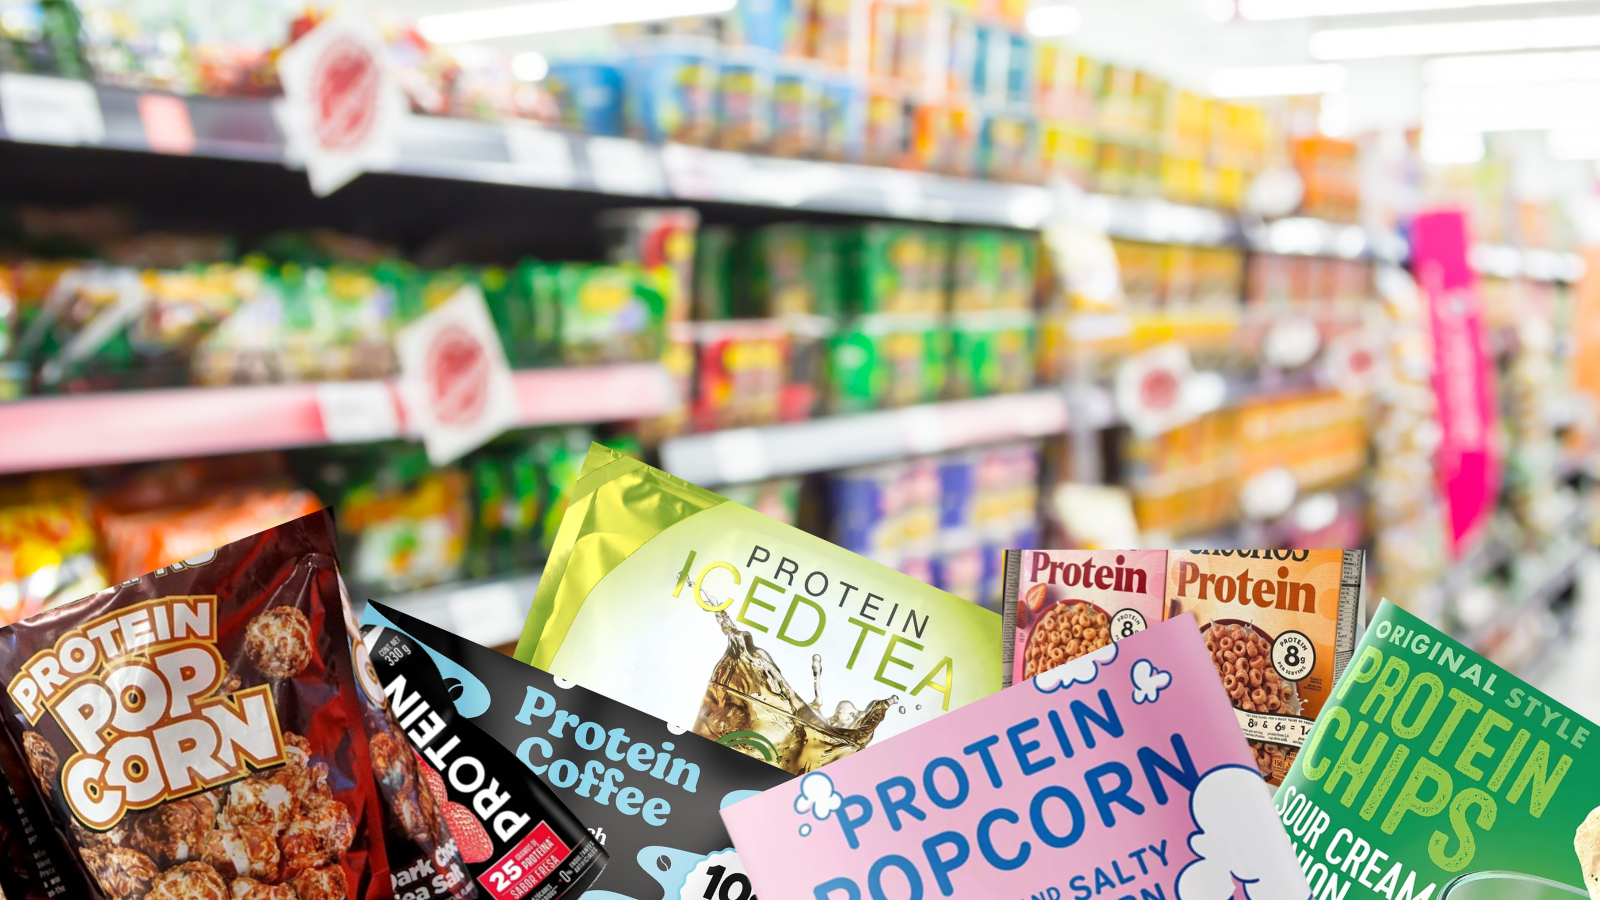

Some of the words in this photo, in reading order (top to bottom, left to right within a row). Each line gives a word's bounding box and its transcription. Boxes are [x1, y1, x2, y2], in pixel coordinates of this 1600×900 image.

[746, 545, 929, 639] PROTEIN
[1030, 552, 1147, 594] Protein
[1117, 614, 1140, 625] PROTEIN
[1177, 561, 1316, 614] Protein
[9, 597, 217, 724] PROTEIN
[384, 647, 404, 667] 330
[401, 644, 412, 656] g
[672, 549, 827, 648] ICED
[845, 616, 953, 712] TEA
[1280, 636, 1308, 652] PROTEIN
[1284, 645, 1306, 667] 8g
[51, 643, 225, 757] POP
[1336, 645, 1574, 819] PROTEIN
[1376, 620, 1498, 696] ORIGINAL
[1504, 687, 1591, 750] STYLE
[63, 687, 284, 828] CORN
[384, 673, 531, 844] PROTEIN
[515, 685, 701, 794] Protein
[515, 736, 671, 827] Coffee
[837, 688, 1125, 850] PROTEIN
[1302, 706, 1498, 873] CHIPS
[395, 886, 431, 900] ea
[431, 862, 465, 894] Salt
[489, 858, 523, 893] 25
[510, 874, 539, 900] SABOR
[534, 854, 560, 880] FRESA
[1069, 838, 1169, 900] SALTY
[1275, 785, 1331, 850] SOUR
[1325, 827, 1437, 900] CREAM
